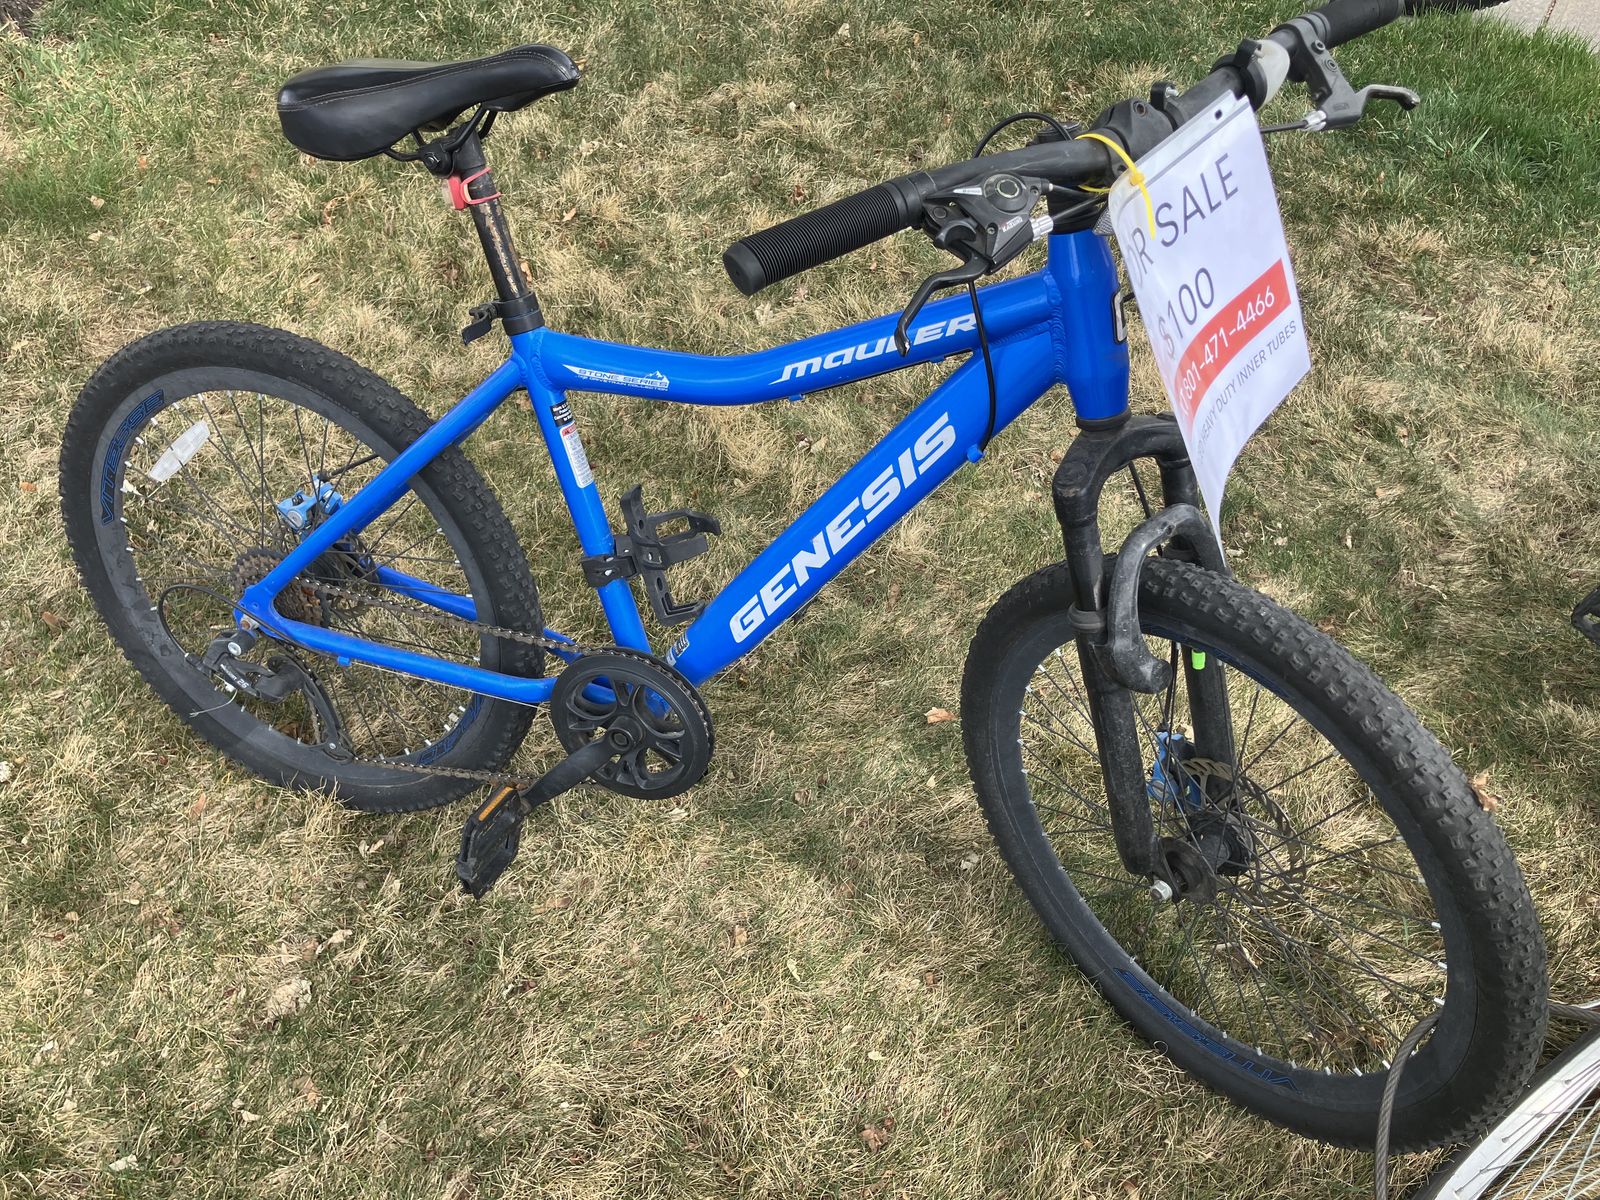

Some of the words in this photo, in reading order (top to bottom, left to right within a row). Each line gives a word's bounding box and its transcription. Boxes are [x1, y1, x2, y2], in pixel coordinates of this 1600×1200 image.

[1155, 153, 1239, 247] SALE
[1157, 267, 1215, 361] $100
[1183, 285, 1276, 400] 801-471-4466
[578, 368, 619, 381] STONE
[622, 375, 668, 388] SERIES
[1202, 404, 1218, 443] HEAVY
[1215, 379, 1239, 413] DUTY
[1236, 349, 1267, 387] INNER
[1266, 320, 1297, 356] TUBES
[728, 411, 957, 644] GENESIS
